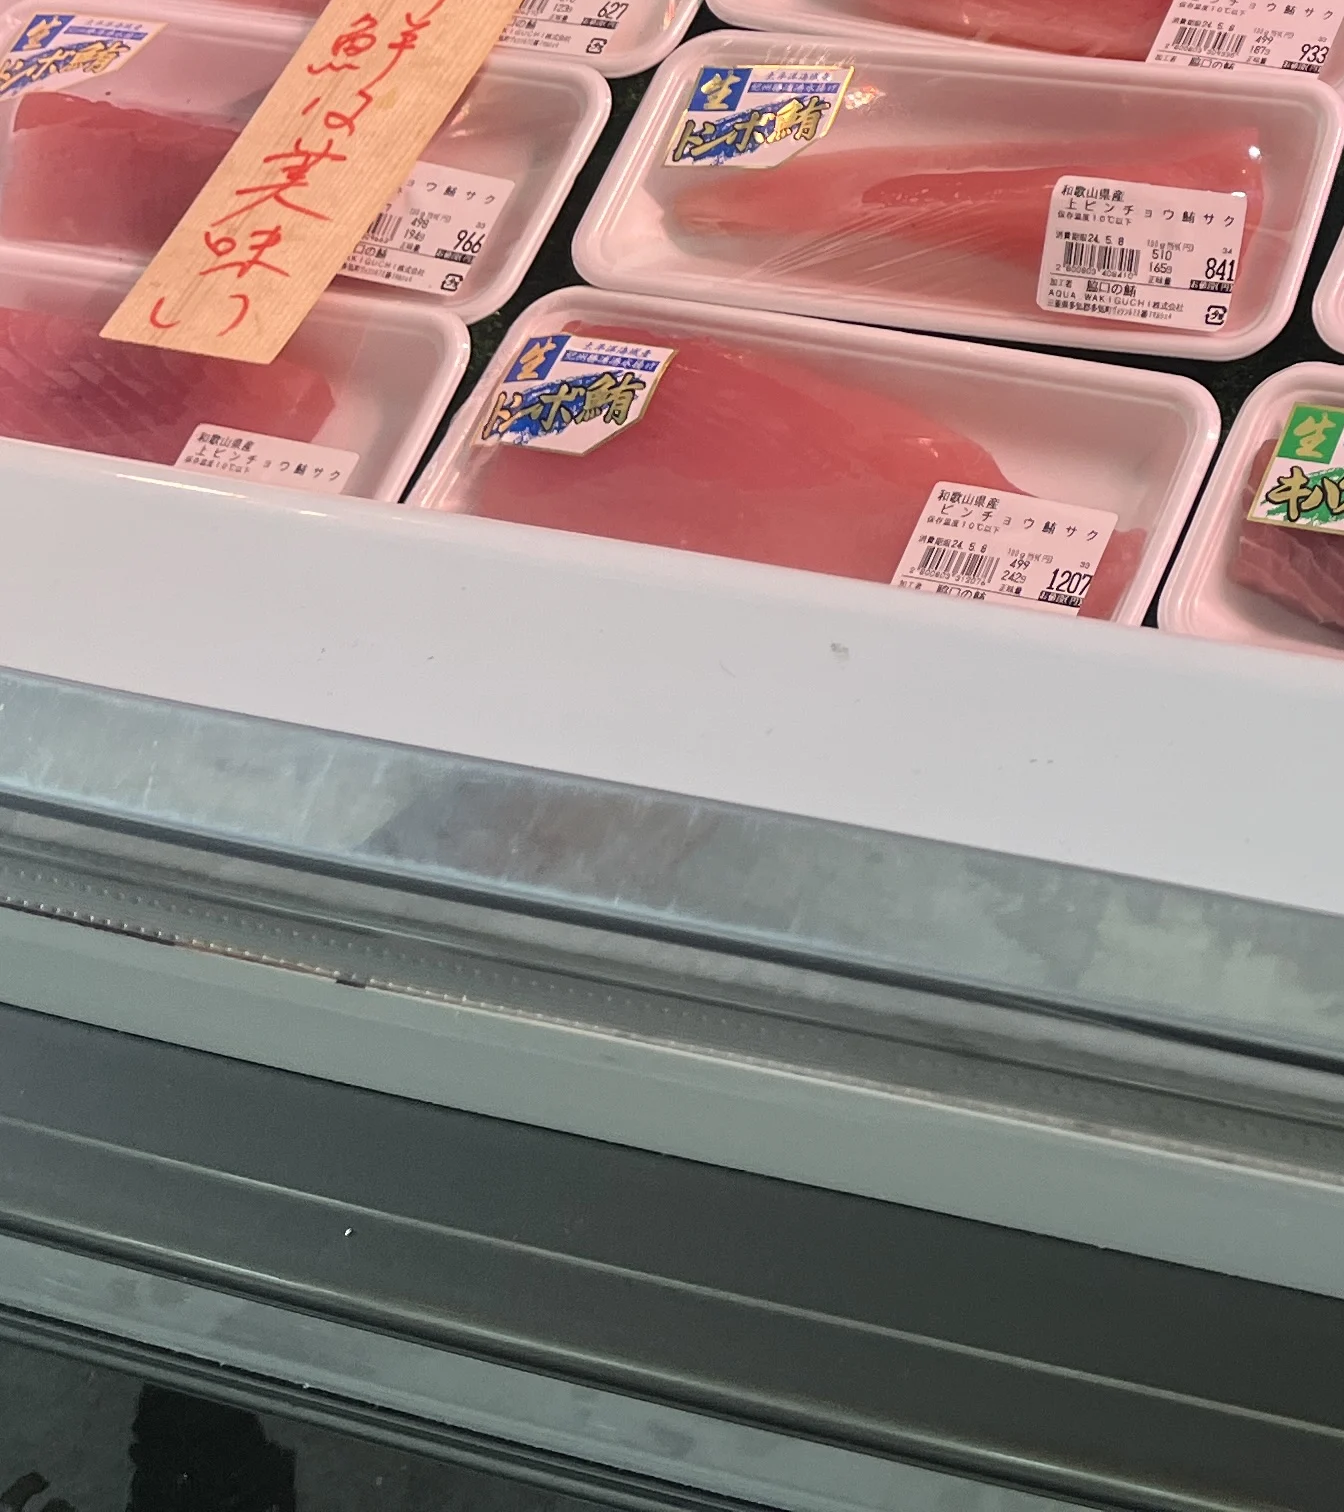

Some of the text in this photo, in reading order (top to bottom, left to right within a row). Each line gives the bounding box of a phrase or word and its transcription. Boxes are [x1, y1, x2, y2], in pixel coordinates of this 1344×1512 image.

[597, 1, 629, 20] 627
[1296, 43, 1329, 64] 933
[701, 68, 739, 108] 生
[669, 96, 830, 161] トンボ鮪
[1060, 184, 1124, 203] 和歌山県産
[454, 230, 485, 253] 966
[1203, 258, 1237, 283] 841
[517, 337, 554, 381] 生
[477, 373, 645, 440] トンボ鮪
[1292, 411, 1335, 459] 生
[935, 488, 1000, 511] 和歌山県産
[1044, 568, 1094, 596] 1207
